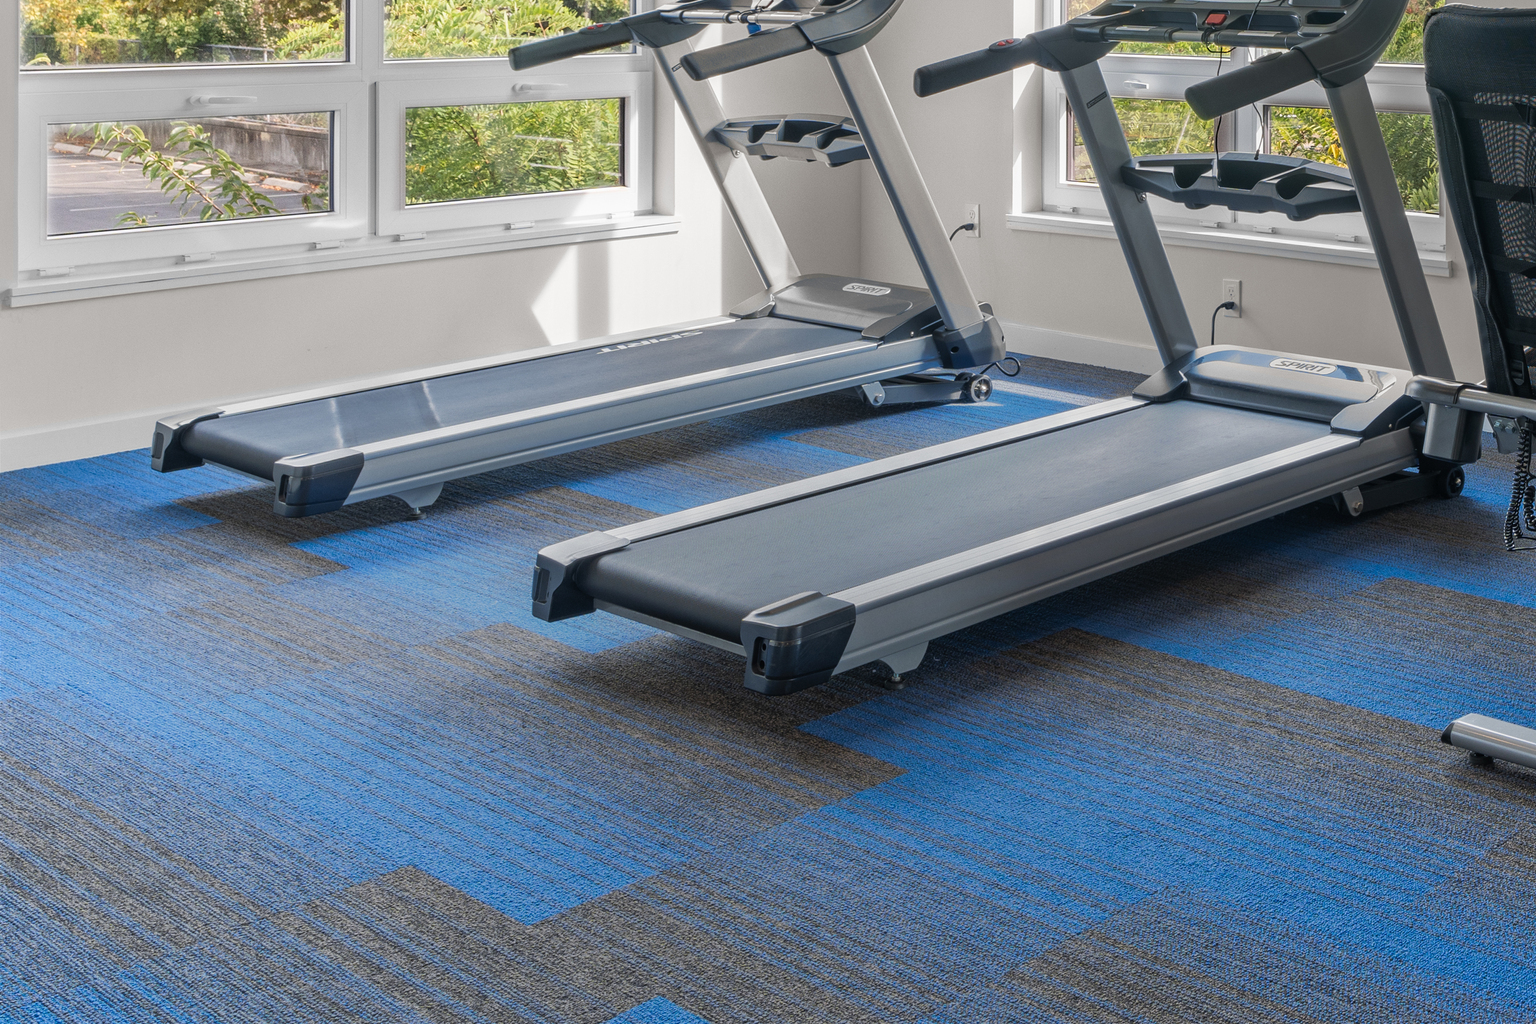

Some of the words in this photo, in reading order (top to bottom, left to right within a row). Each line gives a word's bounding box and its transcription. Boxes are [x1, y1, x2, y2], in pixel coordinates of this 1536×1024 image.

[849, 284, 888, 295] SPIRIT
[596, 329, 703, 355] SPIRIT
[1275, 360, 1331, 373] SPIRIT
